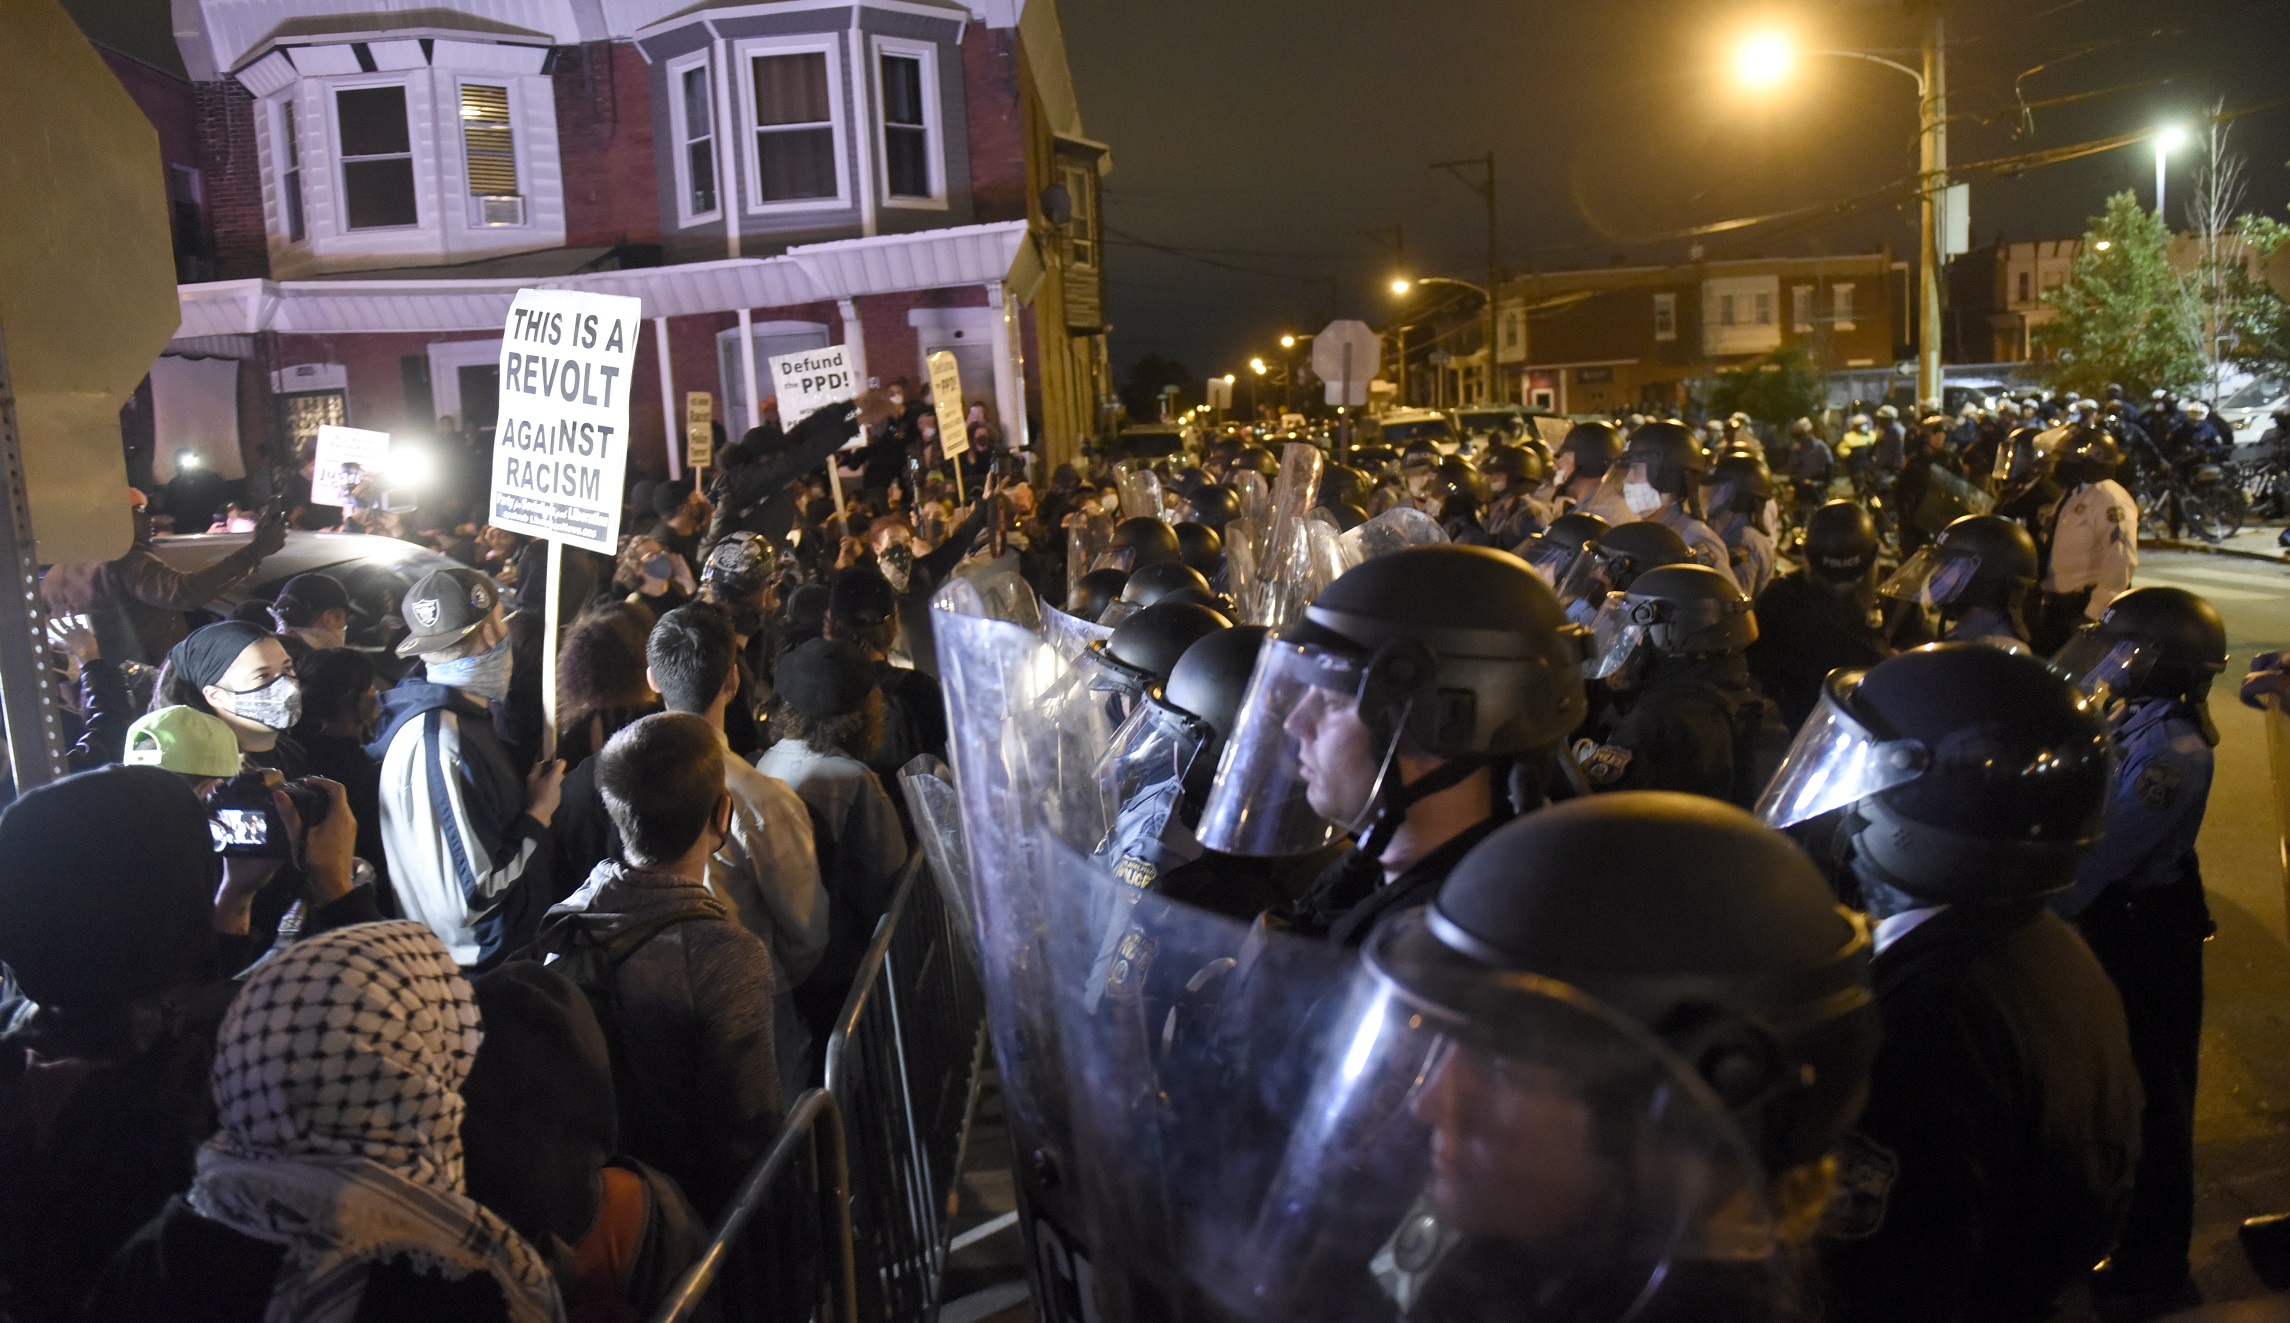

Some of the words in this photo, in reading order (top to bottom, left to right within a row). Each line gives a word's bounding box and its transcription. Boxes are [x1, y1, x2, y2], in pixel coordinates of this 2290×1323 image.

[514, 308, 562, 346] THIS
[573, 313, 598, 349] IS
[605, 318, 624, 354] A
[506, 351, 620, 408] REVOLT
[781, 352, 843, 375] Defund
[801, 371, 849, 394] PPD!
[502, 418, 614, 459] AGAINST
[506, 457, 600, 501] RACISM
